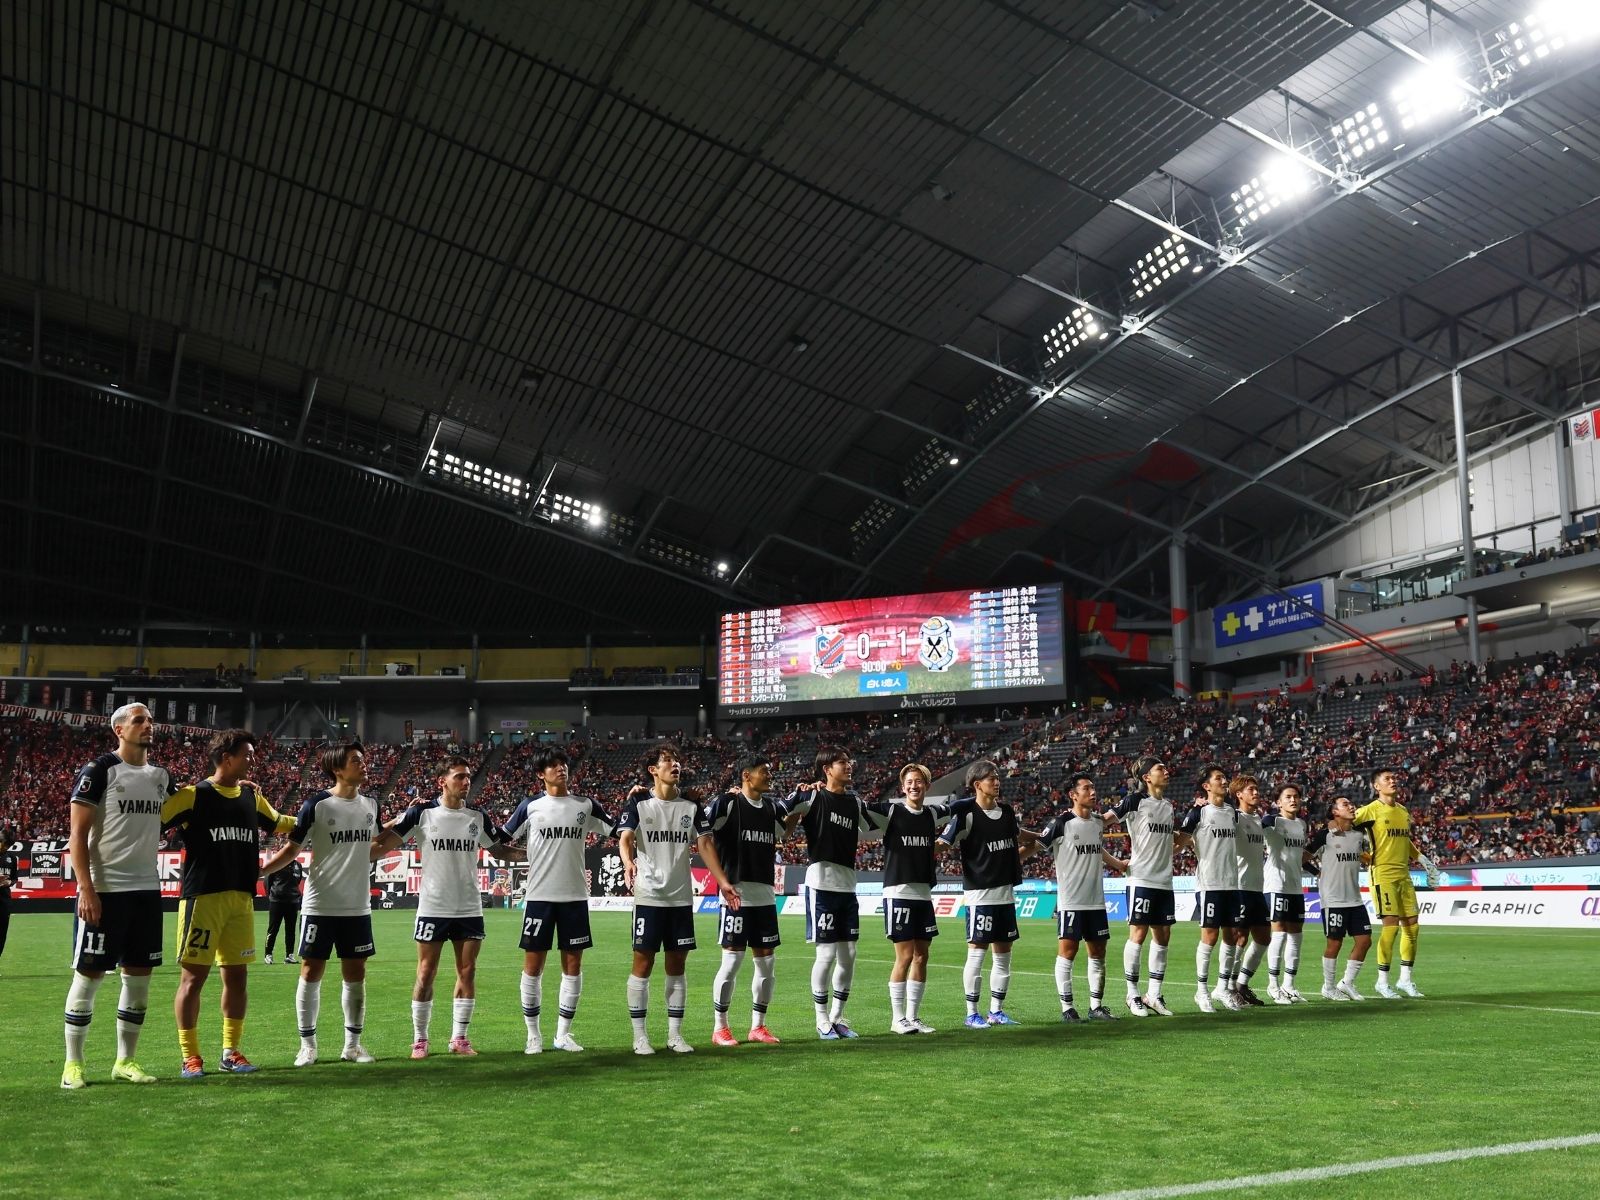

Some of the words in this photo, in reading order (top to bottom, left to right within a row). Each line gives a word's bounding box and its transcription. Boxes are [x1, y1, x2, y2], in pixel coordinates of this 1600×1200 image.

[1268, 618, 1287, 627] SAPPORO
[1022, 631, 1038, 640] 力也
[857, 633, 870, 660] 0
[897, 630, 907, 657] 1
[862, 661, 886, 672] 90:00
[867, 678, 901, 689] 白い恋人
[921, 698, 956, 706] ベルックス
[210, 827, 253, 843] YAMAHA
[540, 827, 582, 840] YAMAHA
[647, 830, 688, 843] YAMAHA
[741, 830, 774, 844] YAMAHA
[35, 854, 59, 863] SAPPORO
[1135, 898, 1150, 914] 20
[1276, 898, 1288, 912] 50
[1384, 893, 1391, 905] 1
[893, 908, 910, 924] 77
[1206, 903, 1214, 917] 6
[1469, 903, 1544, 915] GRAPHIC
[725, 916, 743, 934] 38
[818, 913, 834, 930] 42
[976, 914, 992, 931] 36
[1067, 912, 1075, 926] 7
[1329, 913, 1343, 927] 39
[306, 924, 317, 943] 8
[416, 921, 435, 941] 16
[523, 918, 542, 936] 27
[636, 917, 645, 936] 3
[84, 932, 105, 954] 11
[189, 928, 210, 950] 21
